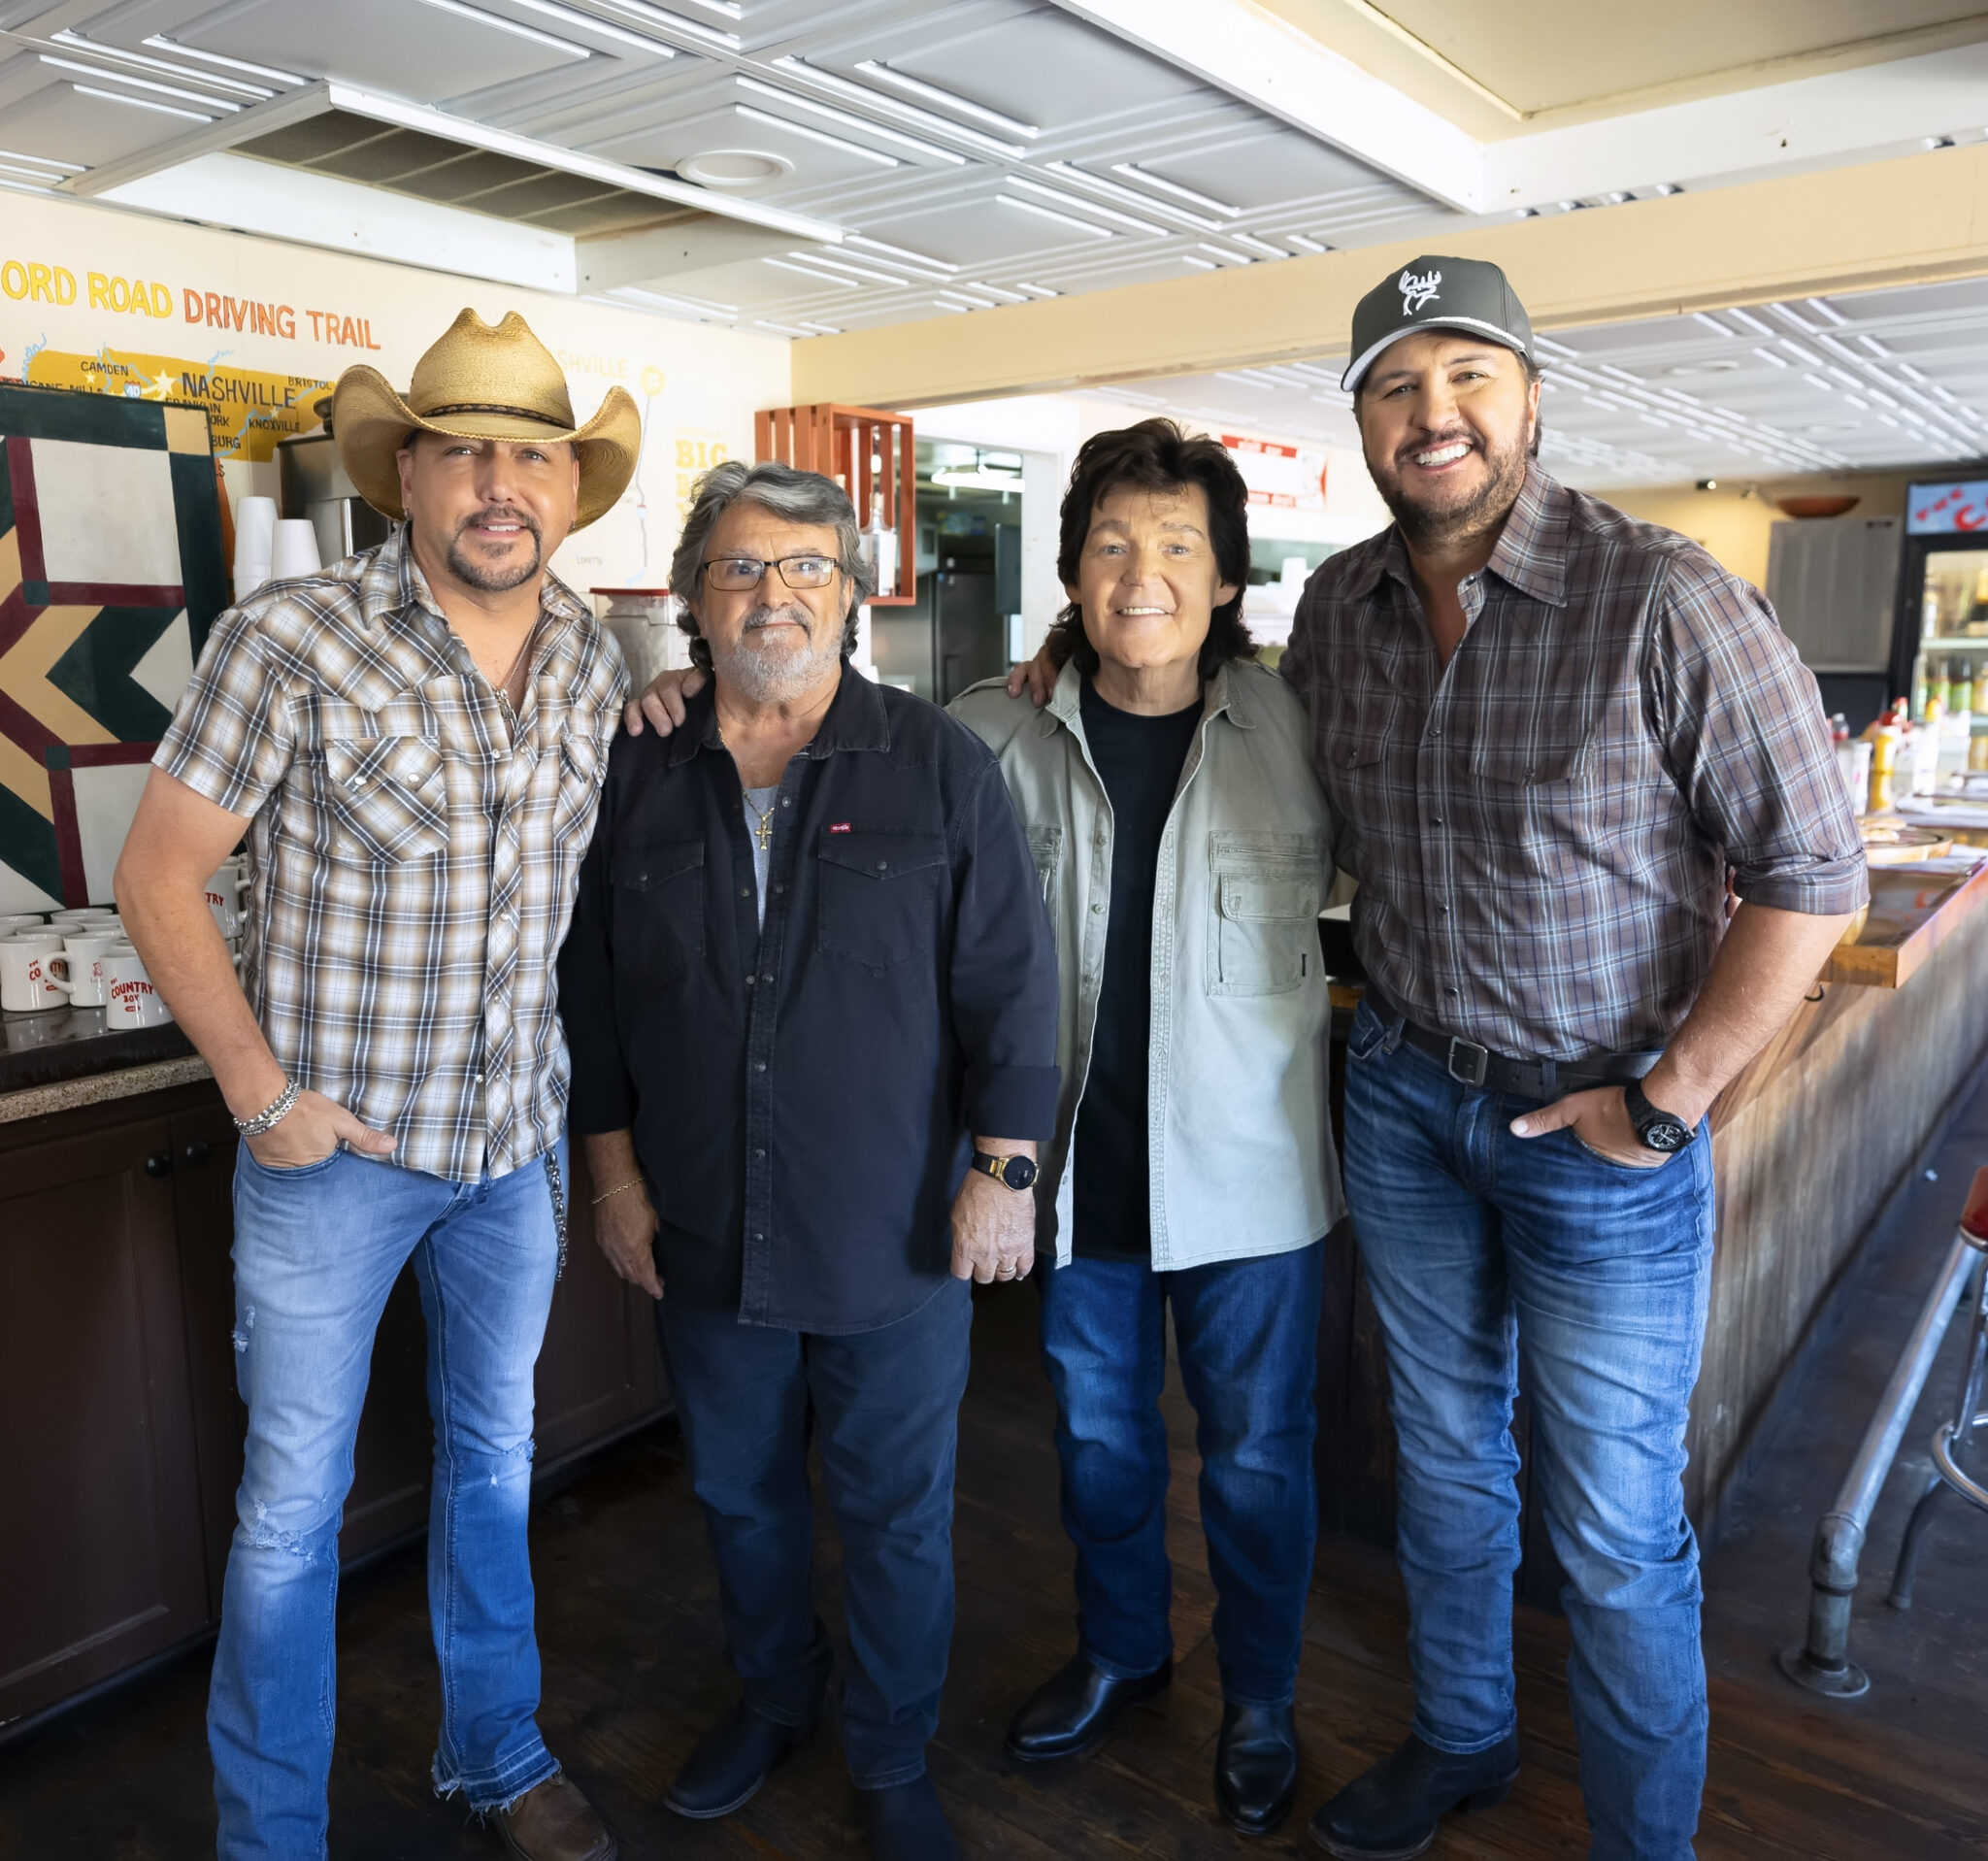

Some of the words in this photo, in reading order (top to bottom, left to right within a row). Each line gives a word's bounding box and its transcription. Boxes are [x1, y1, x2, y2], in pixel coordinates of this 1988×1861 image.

[1, 260, 77, 306] ORD
[87, 271, 173, 318] ROAD
[182, 288, 295, 340] DRIVING
[306, 310, 381, 350] TRAIL
[81, 361, 129, 377] CAMDEN
[182, 372, 296, 410] NASHVILLE
[288, 376, 331, 390] BRISTOL
[248, 418, 301, 433] KNOXVILLE
[111, 980, 153, 1000] COUNTRY
[123, 994, 139, 1003] BOY
